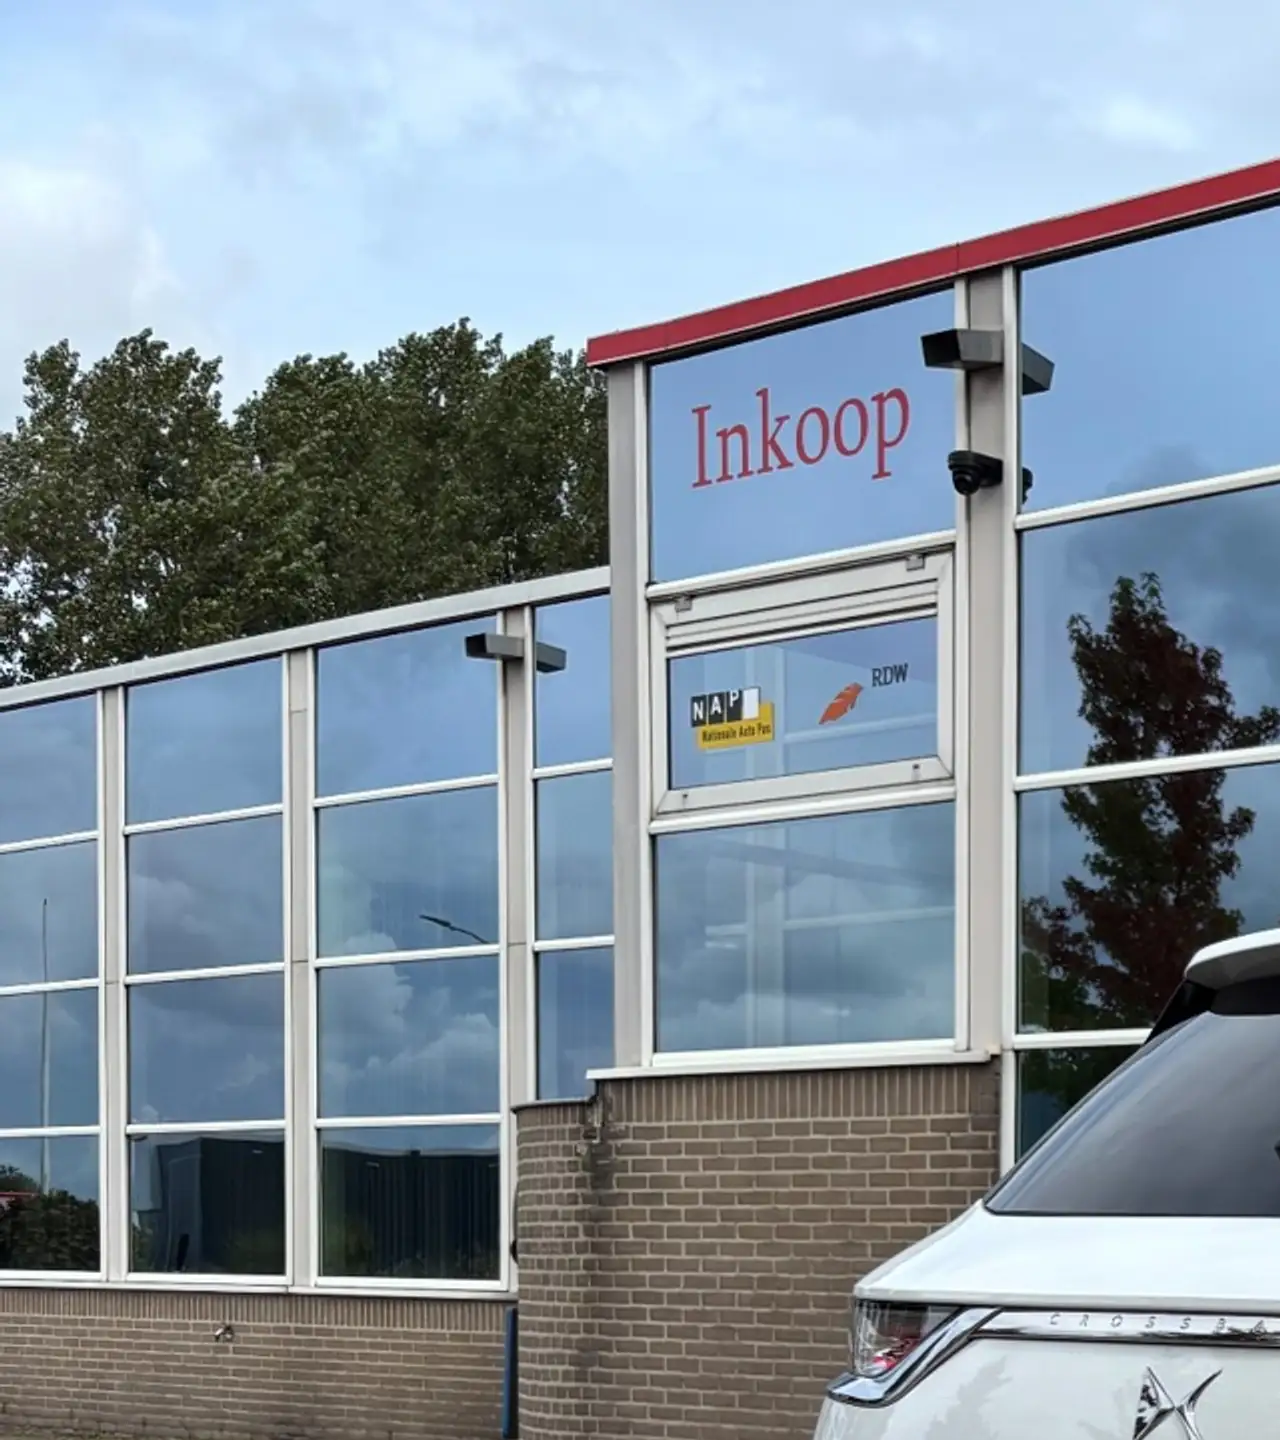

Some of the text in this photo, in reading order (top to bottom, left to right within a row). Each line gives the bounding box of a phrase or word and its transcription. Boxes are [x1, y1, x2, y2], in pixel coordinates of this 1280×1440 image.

[691, 387, 909, 488] Inkoop
[871, 662, 909, 687] RDW
[692, 689, 741, 722] NAP
